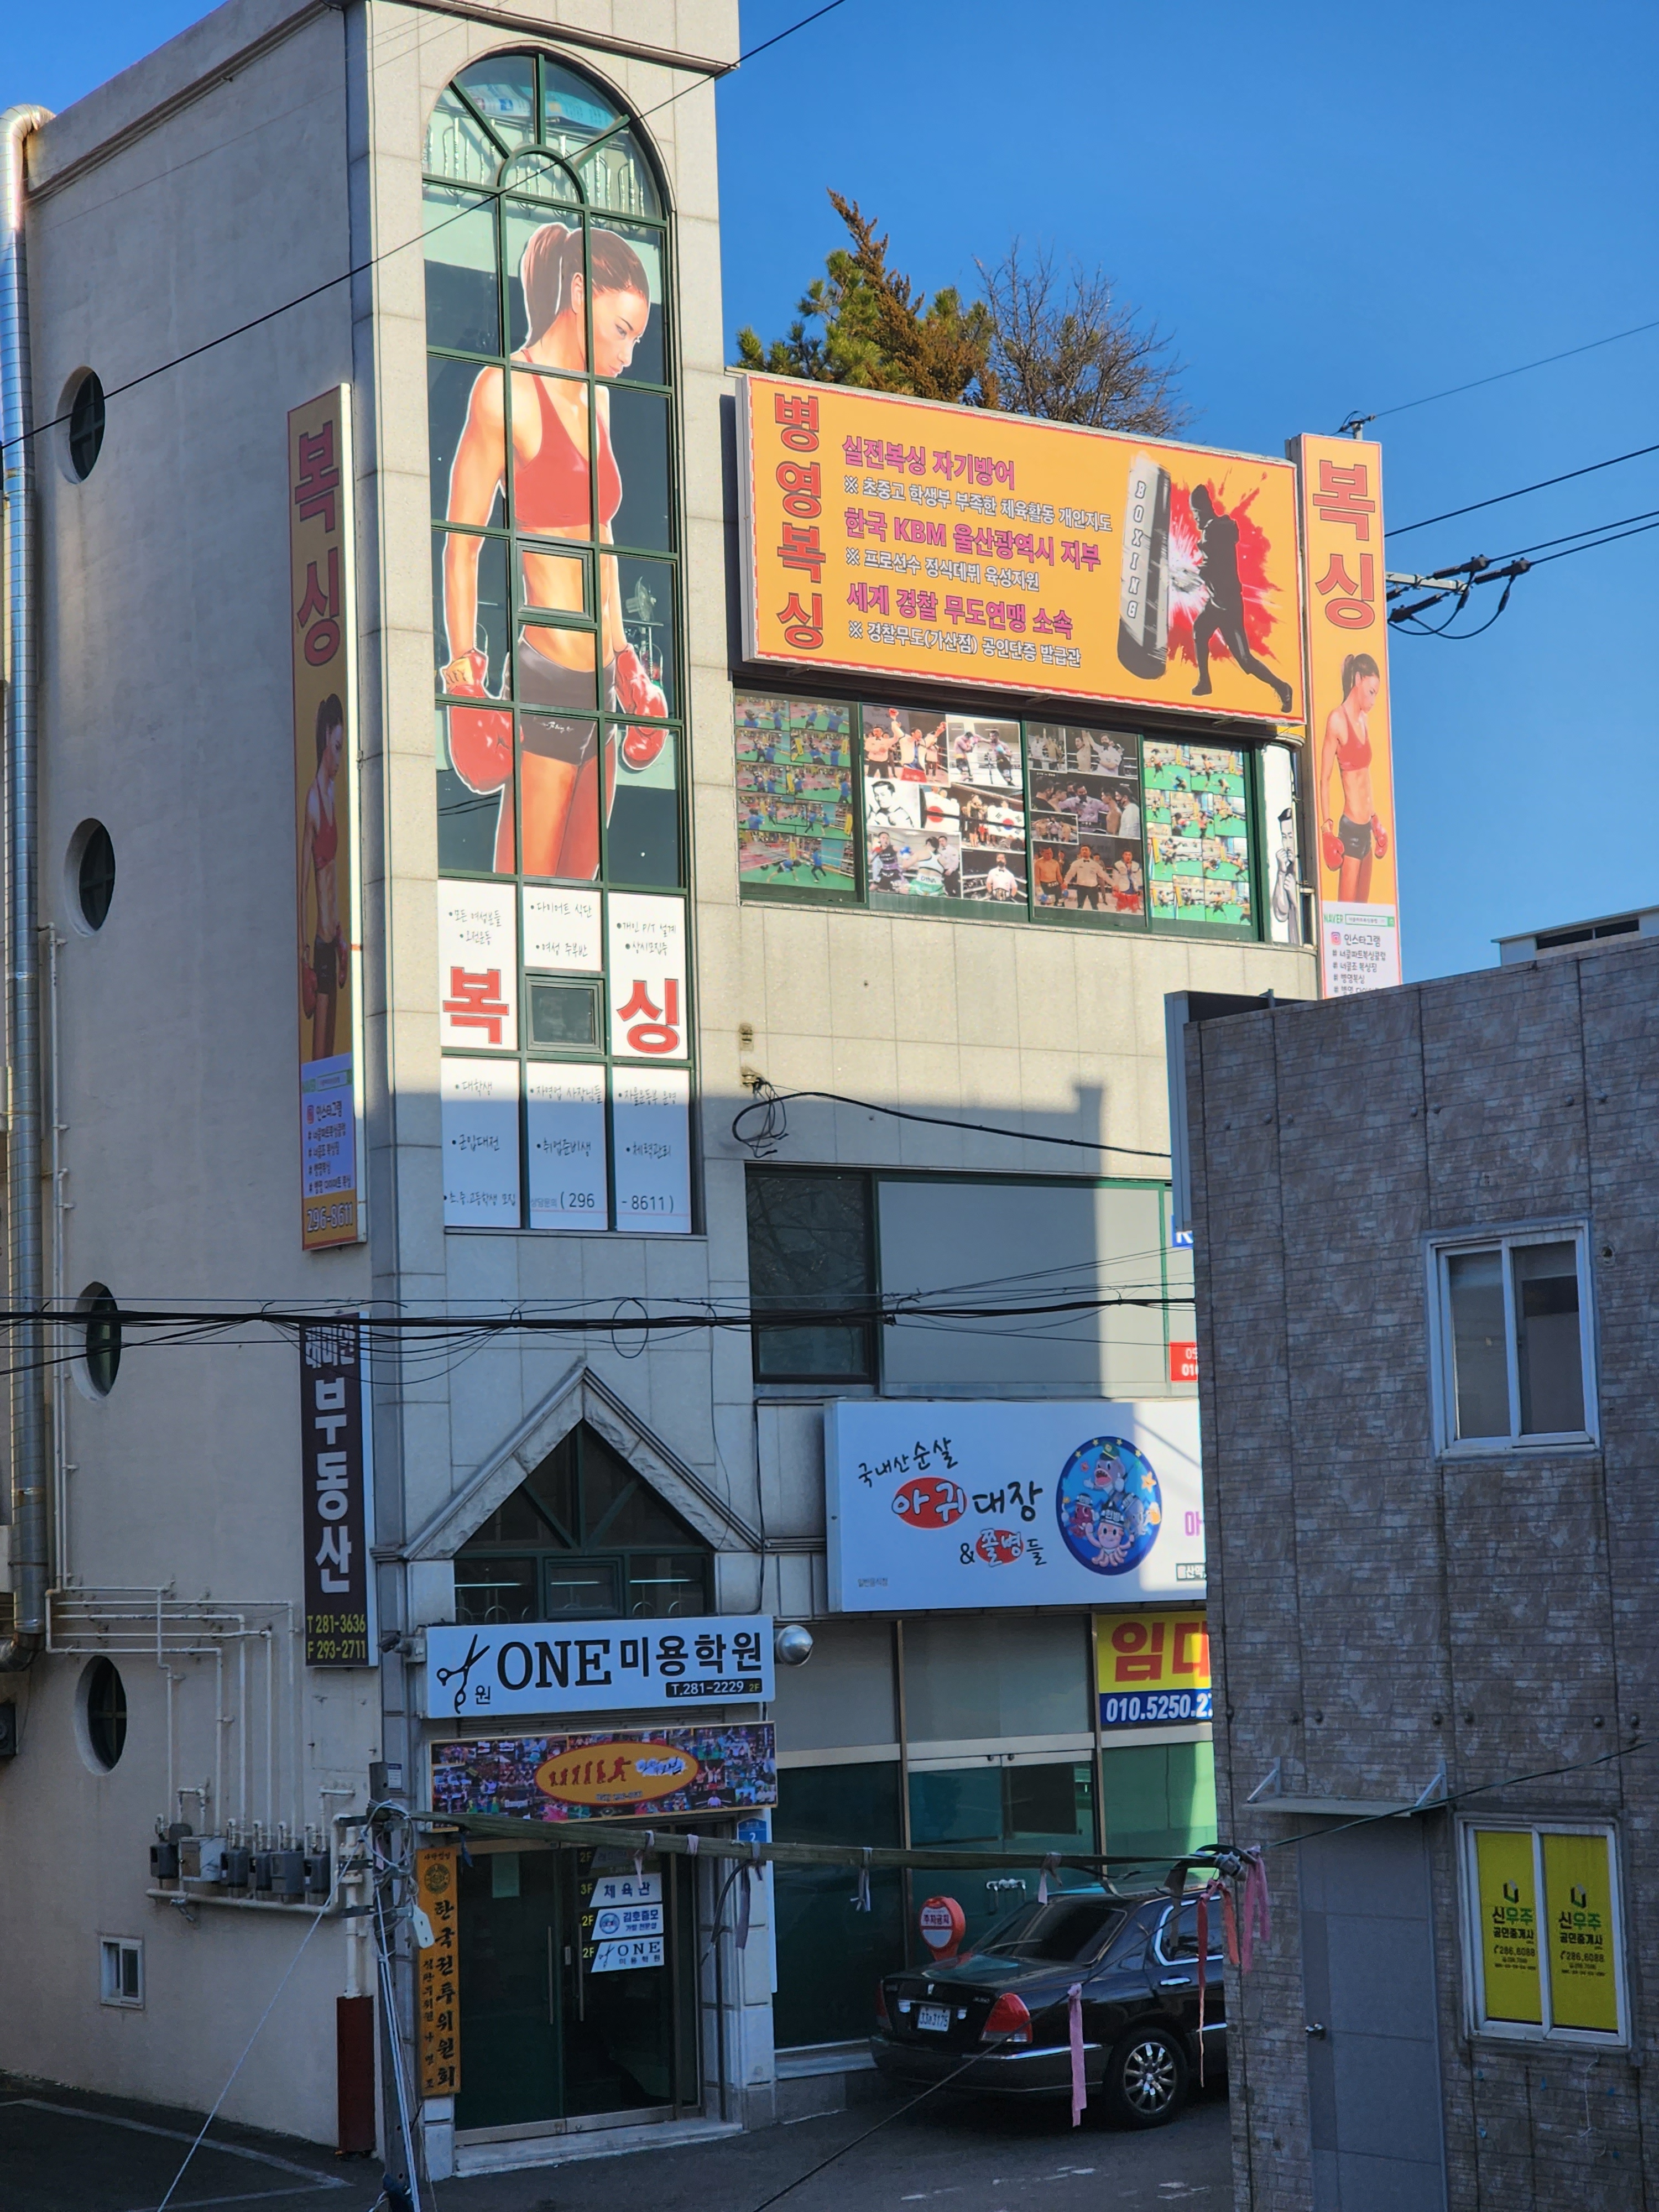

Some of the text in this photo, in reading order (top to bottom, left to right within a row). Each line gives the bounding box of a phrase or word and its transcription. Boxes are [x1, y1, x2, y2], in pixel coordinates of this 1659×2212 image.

[842, 435, 1014, 491] 실전복싱 자기방어
[862, 477, 906, 501] 초중고
[909, 484, 951, 509] 학생부
[955, 492, 997, 517] 부족한
[1000, 499, 1055, 524] 체육활동
[1059, 507, 1113, 531] 개인지도
[775, 393, 826, 650] 병영복싱
[295, 420, 340, 666] 복싱
[844, 507, 1101, 572] 한국 KBM 울산광역시 지부
[1312, 460, 1376, 630] 복싱
[1126, 481, 1145, 619] BOXING
[864, 549, 921, 575] 프로선수
[925, 557, 980, 584] 정식데뷔
[984, 566, 1040, 592] 육성지원
[847, 582, 1073, 640] 세계 경찰 무도연맹 소속
[867, 622, 978, 655] 경찰무도(가산점)
[982, 637, 1037, 662] 공인단증
[1040, 644, 1082, 668] 발급관
[455, 909, 502, 927] 모든 여성분들
[537, 902, 592, 918] 다이어트 식단
[466, 931, 492, 946] 오전운동
[623, 921, 639, 933] 개인
[660, 924, 676, 937] 설계
[542, 942, 588, 958] 여성 주부반
[633, 942, 667, 956] 상시모집중
[1344, 934, 1381, 947] 인스타그램
[462, 1079, 492, 1097] 대학생
[536, 1085, 603, 1104] 자영업 사장님들
[663, 1091, 676, 1105] 운영
[459, 1134, 500, 1152] 군입대전
[542, 1138, 591, 1157] 취업준비생
[633, 1141, 671, 1159] 체력관리
[502, 1193, 515, 1207] 모집
[306, 1202, 353, 1233] 296-8611
[315, 1378, 352, 1594] 부동산
[307, 1614, 366, 1634] T 281-3636
[308, 1640, 366, 1659] F 293-2711
[498, 1632, 762, 1691] ONE 미용학원
[474, 1685, 491, 1705] 원
[671, 1680, 760, 1696] T.281-2229 2F
[581, 1882, 651, 1899] 3F 체육관
[582, 1915, 593, 1926] 2F
[924, 1914, 950, 1925] 주차금지
[1493, 1906, 1533, 1926] 신우주
[1559, 1911, 1601, 1931] 신우주
[1494, 1927, 1534, 1939] 공인중개사
[1560, 1932, 1603, 1945] 공인중개사
[583, 1941, 660, 1958] 2F ONE
[435, 1900, 456, 2088] 한국권투위원회
